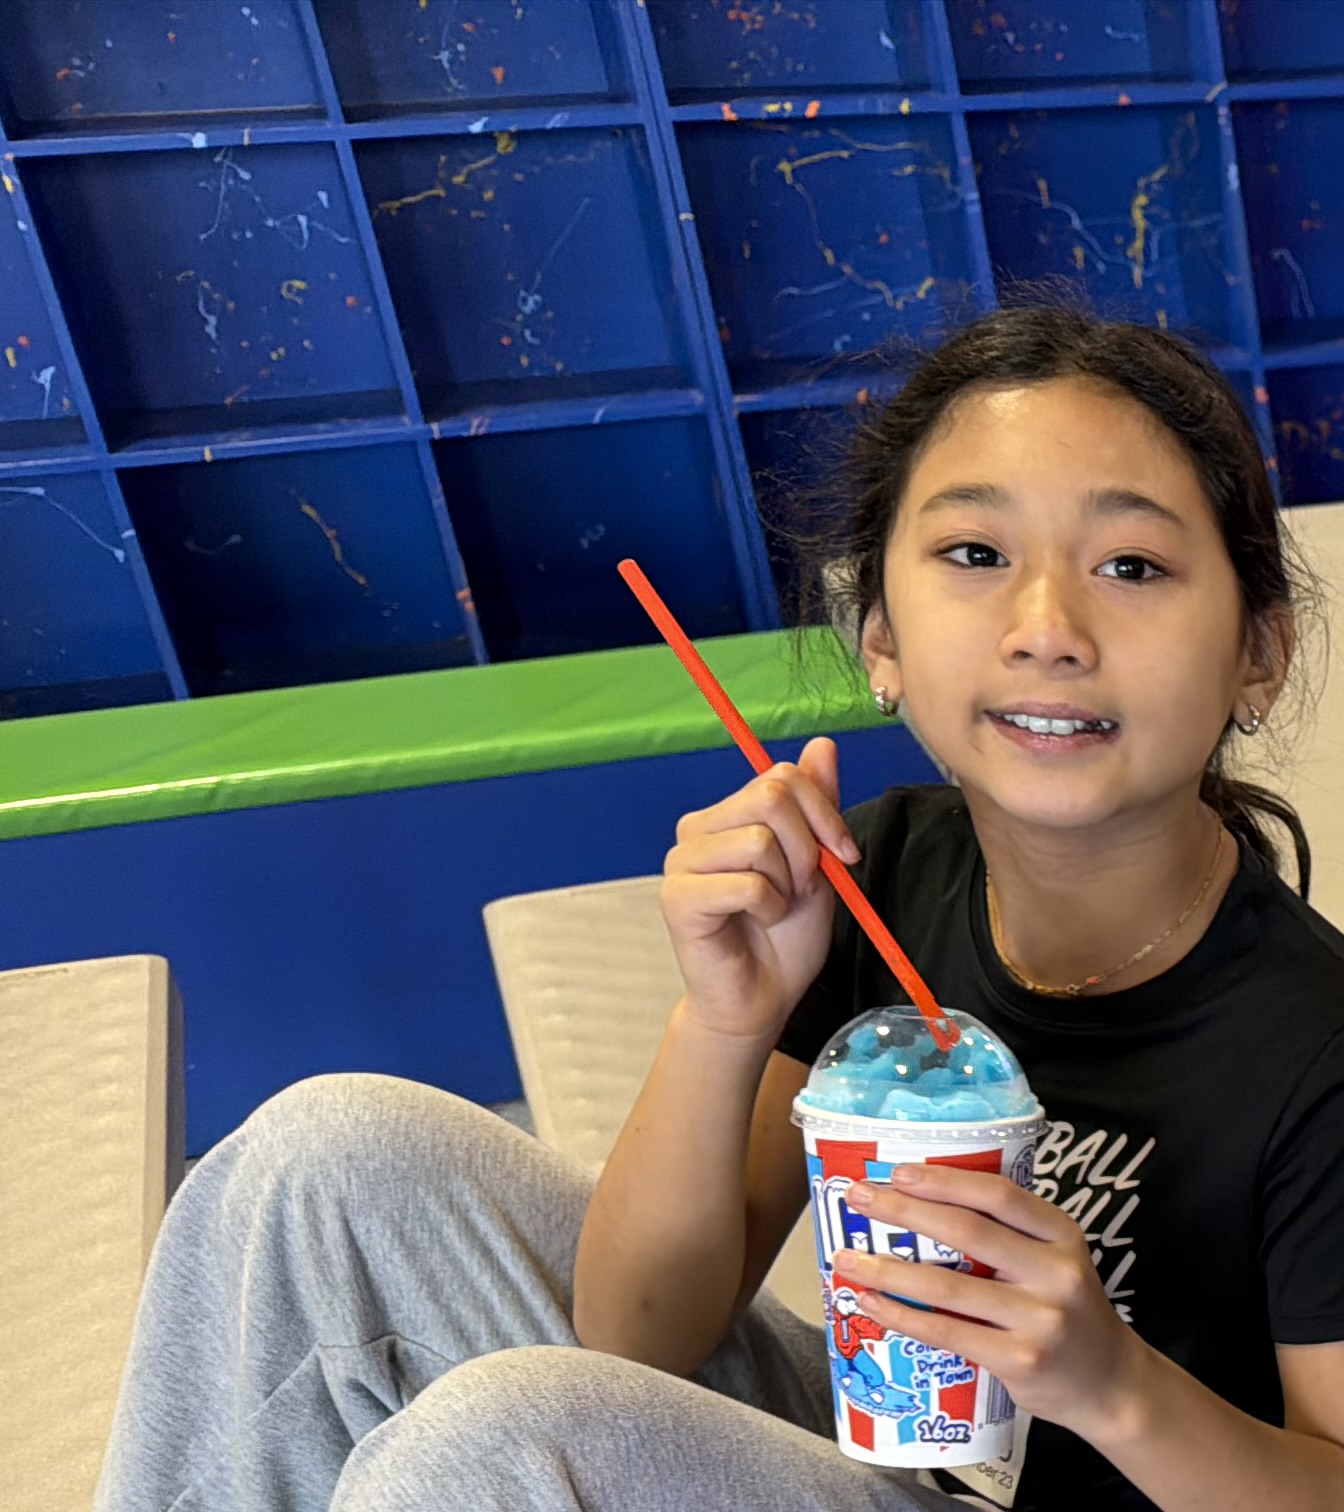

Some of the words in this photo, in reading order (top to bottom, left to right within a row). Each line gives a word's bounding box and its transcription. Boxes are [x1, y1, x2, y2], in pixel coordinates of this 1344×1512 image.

[917, 1353, 964, 1374] Drink
[914, 1375, 930, 1389] in
[934, 1369, 973, 1386] Town
